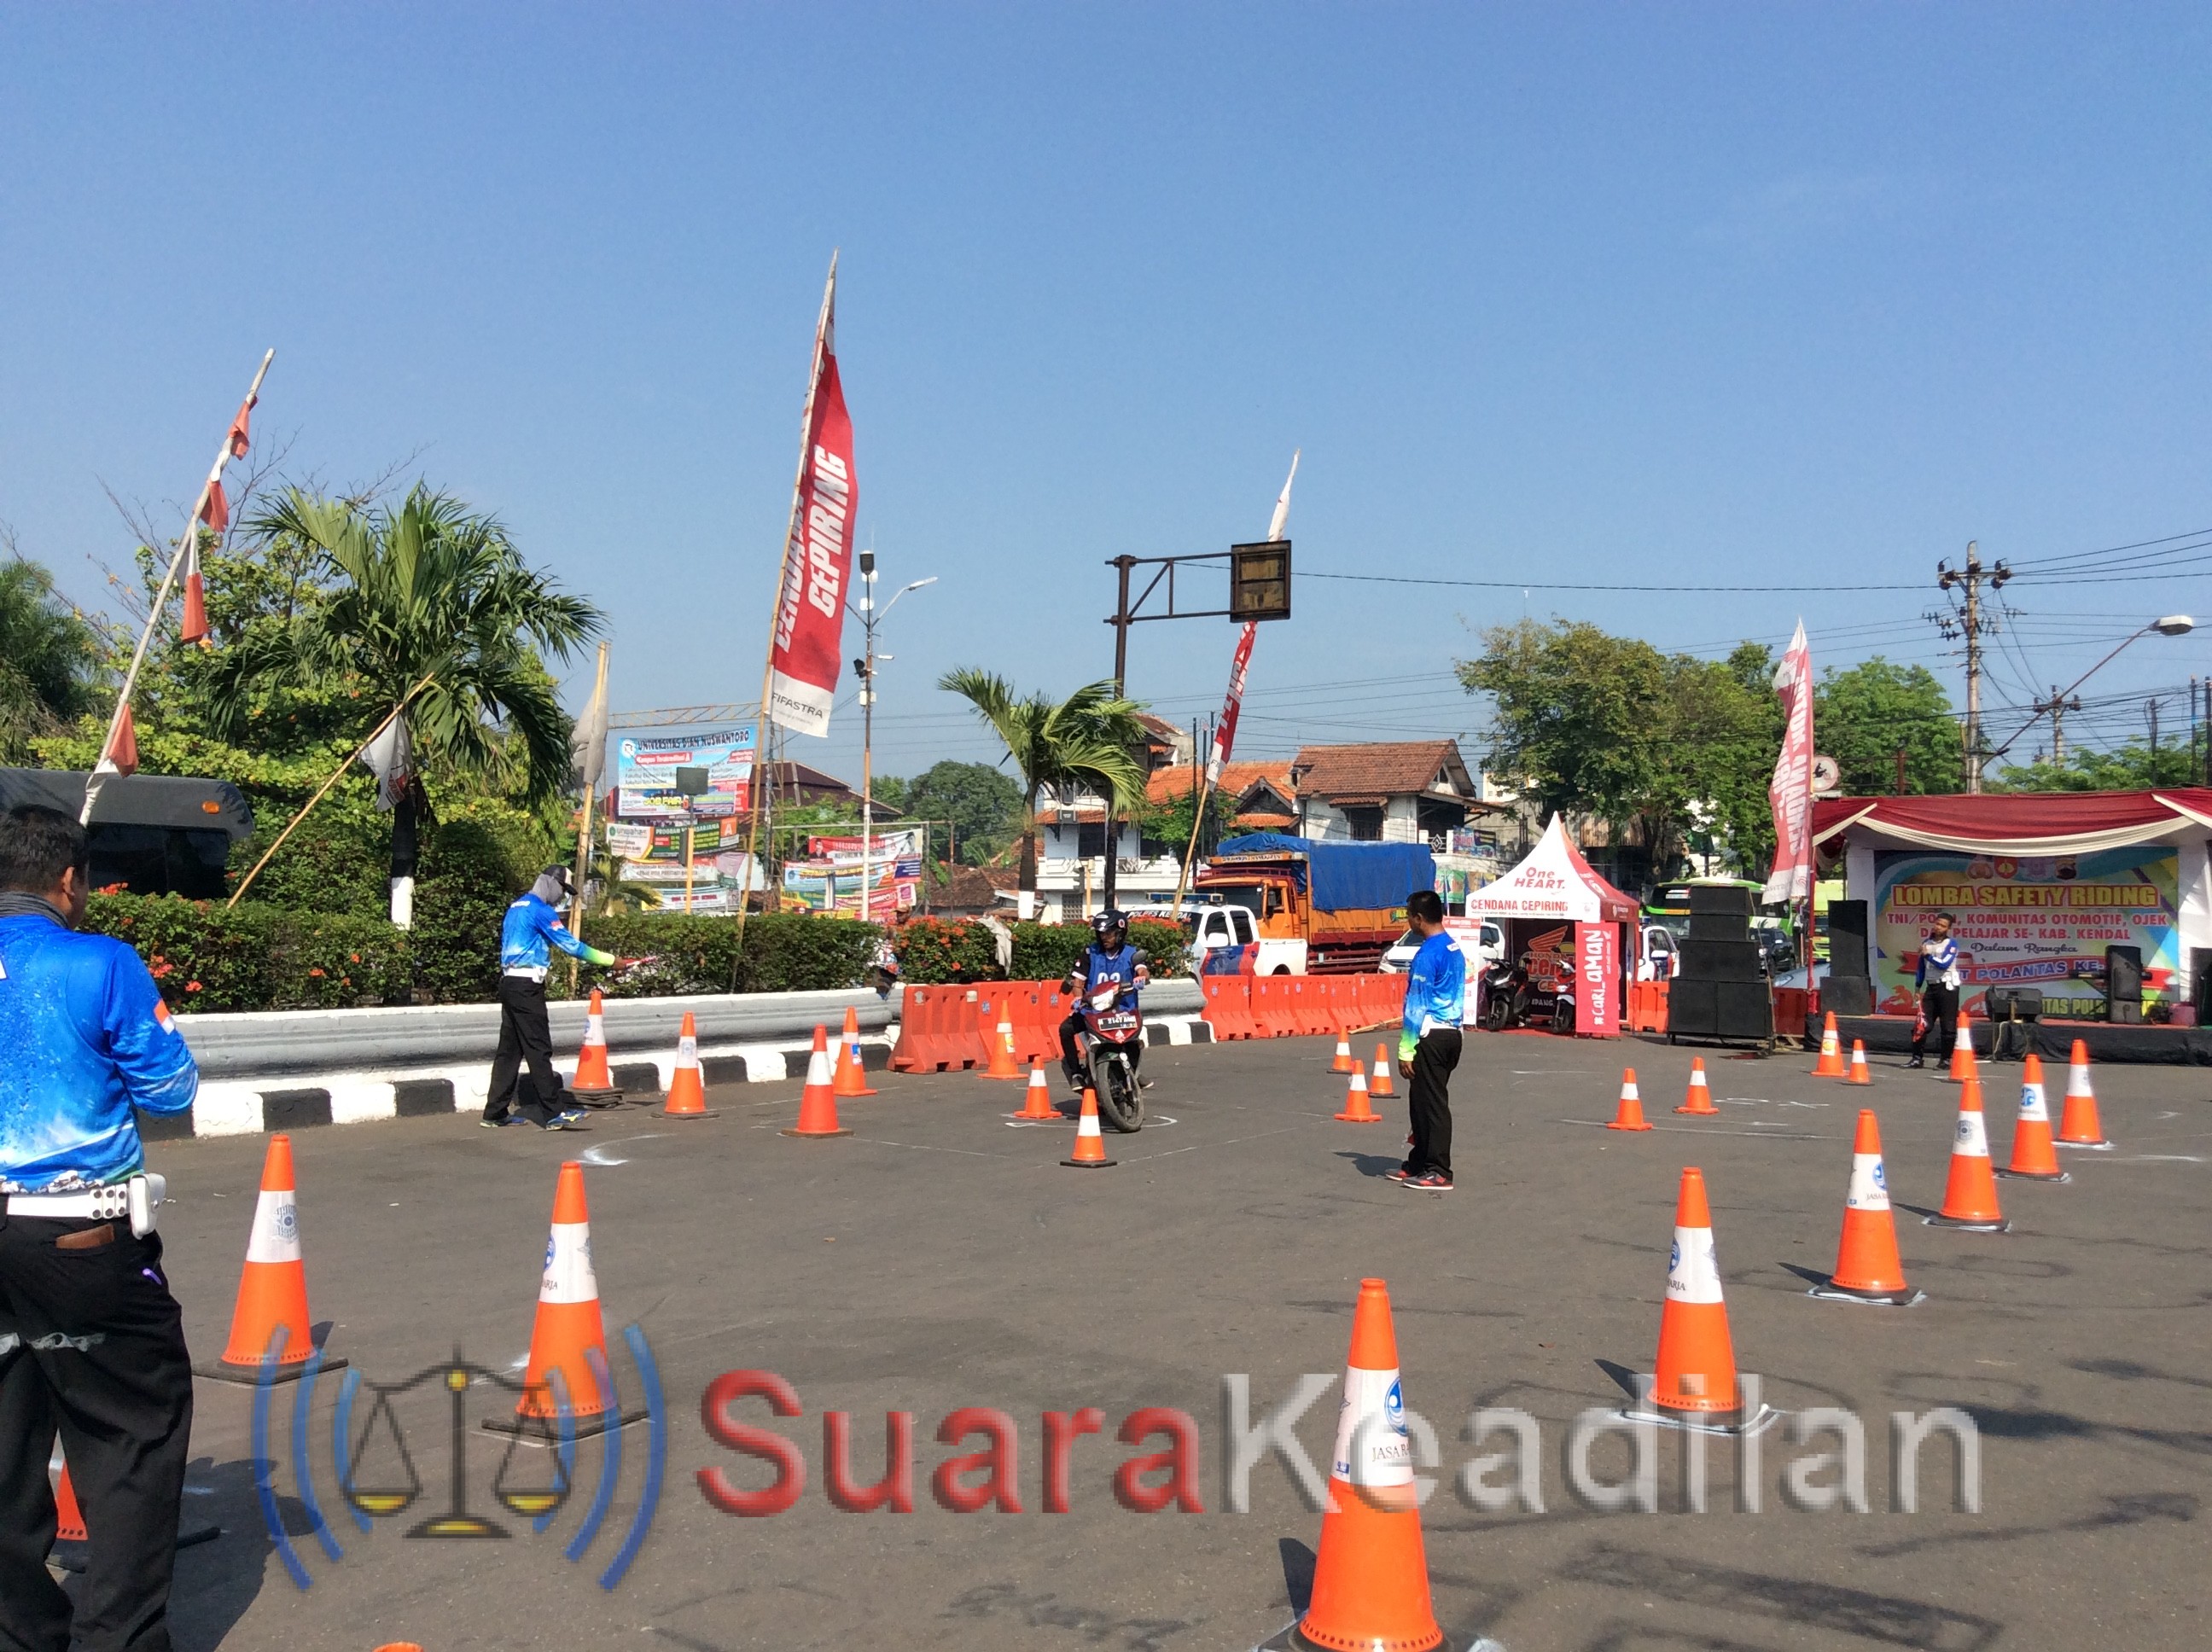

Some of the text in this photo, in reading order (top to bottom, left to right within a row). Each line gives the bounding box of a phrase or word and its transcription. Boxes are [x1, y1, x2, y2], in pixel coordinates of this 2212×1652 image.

[771, 692, 824, 718] FIFASTRA
[1526, 866, 1555, 878] One
[1894, 886, 2157, 906] LOMBA SAFETY RIDING
[1470, 899, 1569, 912] CENDANA CEPIRING
[1159, 910, 1192, 919] KEDAL
[1967, 913, 2046, 925] KOMUNITAS
[2051, 914, 2127, 927] OTOMOTIF,
[2133, 914, 2167, 925] OJEK
[1953, 928, 2009, 939] PELAJAR
[2038, 928, 2071, 939] KAB.
[2076, 928, 2131, 939] KENDAL
[1970, 942, 2078, 955] Dalam Rangka
[1976, 960, 2067, 980] POLANTAS
